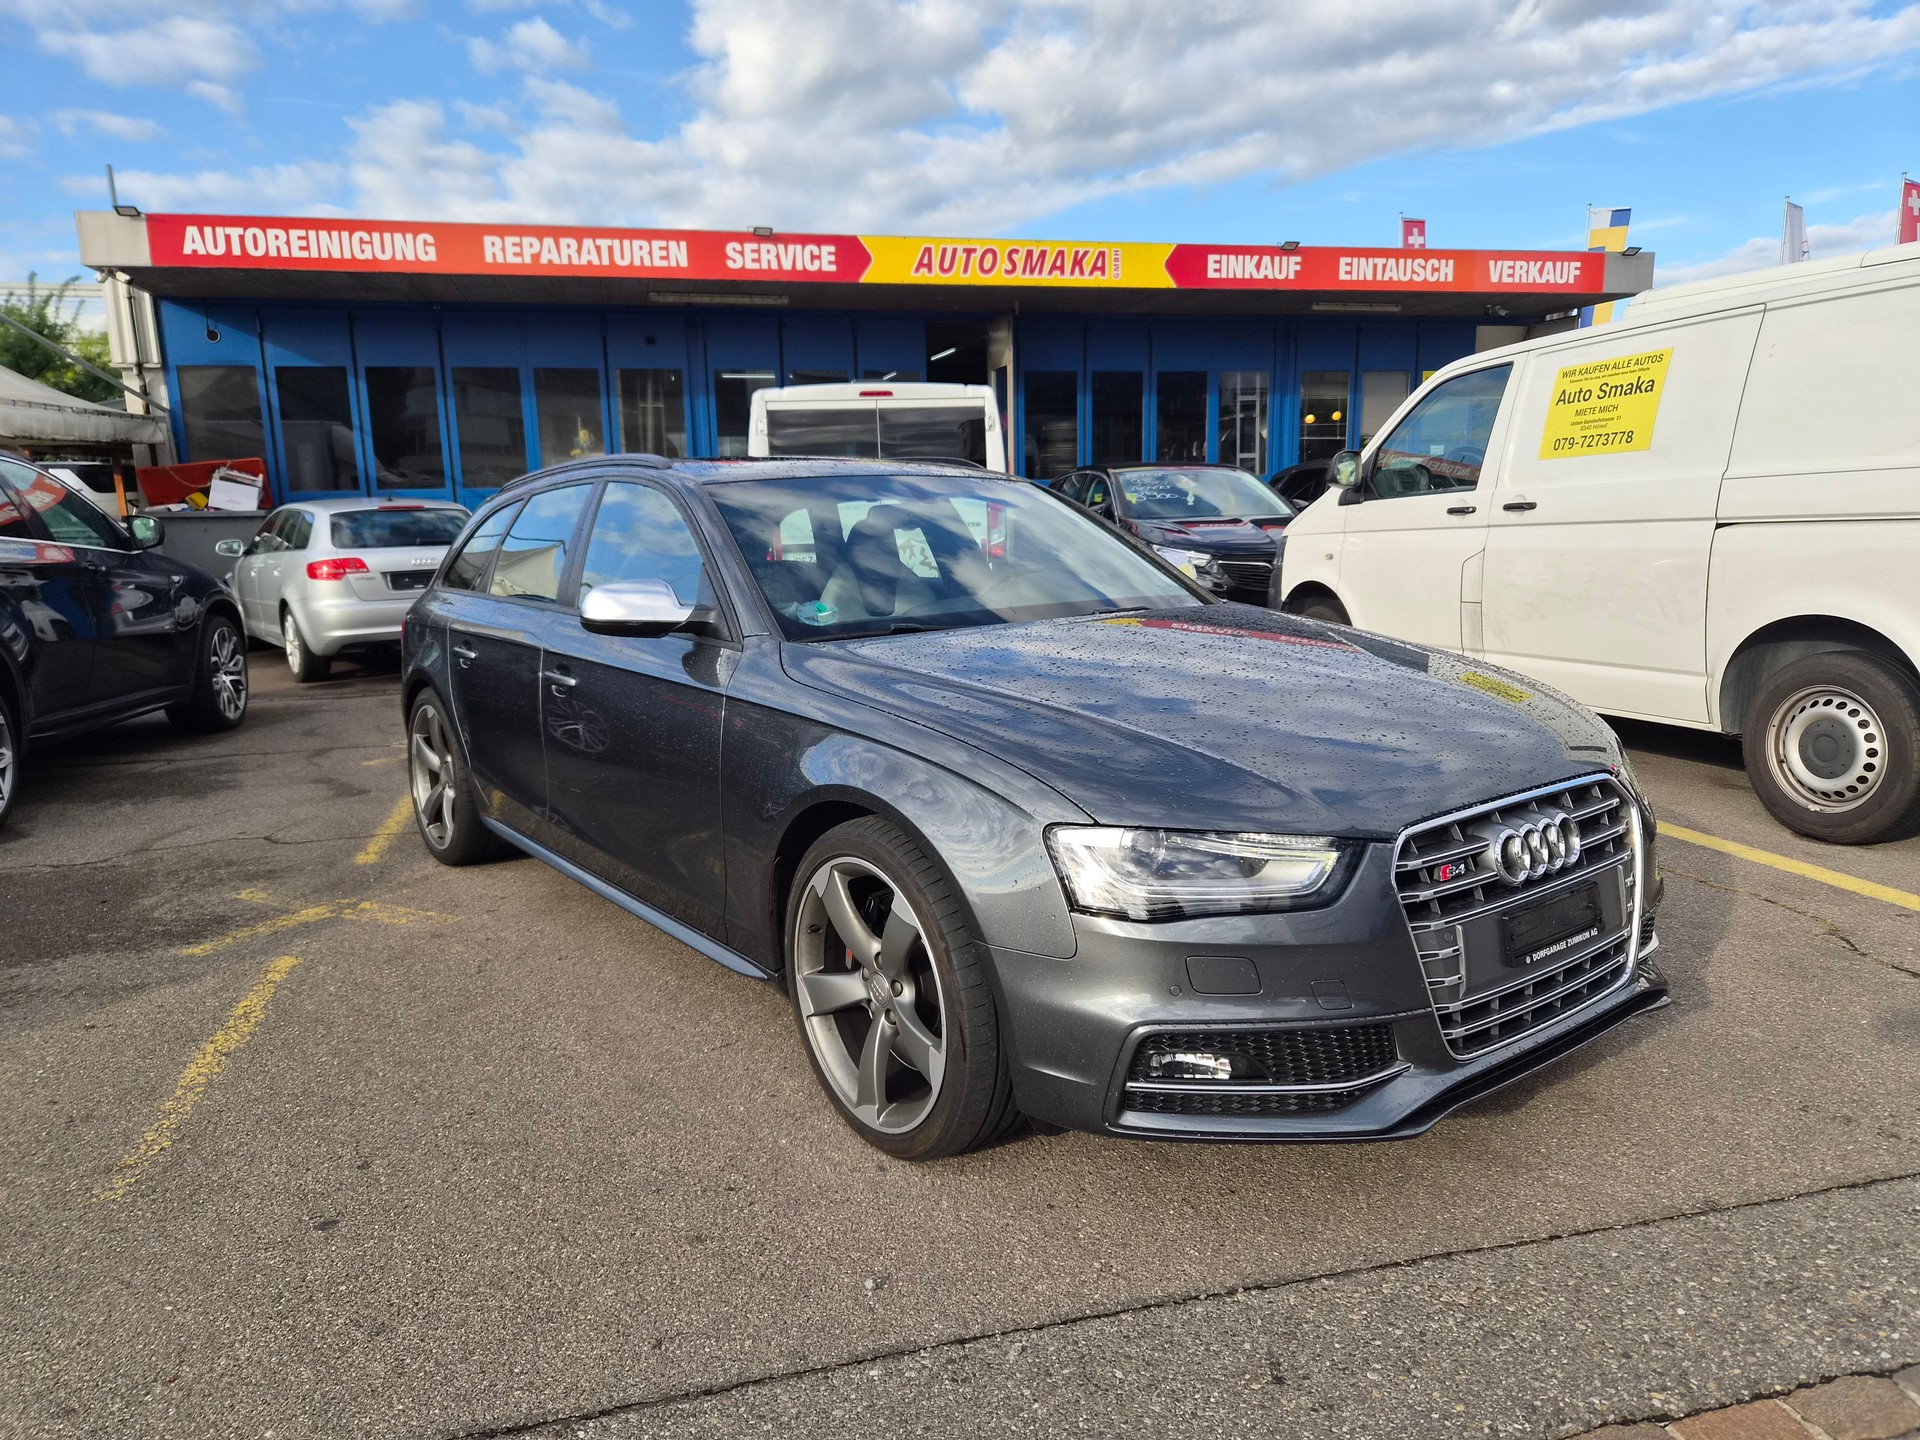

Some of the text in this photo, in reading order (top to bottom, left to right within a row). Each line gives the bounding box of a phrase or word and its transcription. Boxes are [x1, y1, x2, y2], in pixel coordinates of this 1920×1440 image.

[183, 225, 436, 263] AUTOREINIGUNG
[483, 234, 688, 268] REPARATUREN
[726, 240, 837, 272] SERVICE
[1112, 249, 1121, 279] GMBH
[1207, 254, 1301, 280] EINKAUF
[1338, 257, 1454, 282] EINTAUSCH
[1489, 260, 1581, 284] VERKAUF
[1562, 353, 1664, 379] WIR KAUFEN ALLE AUTOS
[1556, 376, 1655, 407] Auto Smaka
[1574, 403, 1619, 417] MIETE MICH
[1553, 430, 1634, 450] 079-7273778
[1532, 927, 1598, 962] DORFGARAGE ZUMIKON AG
